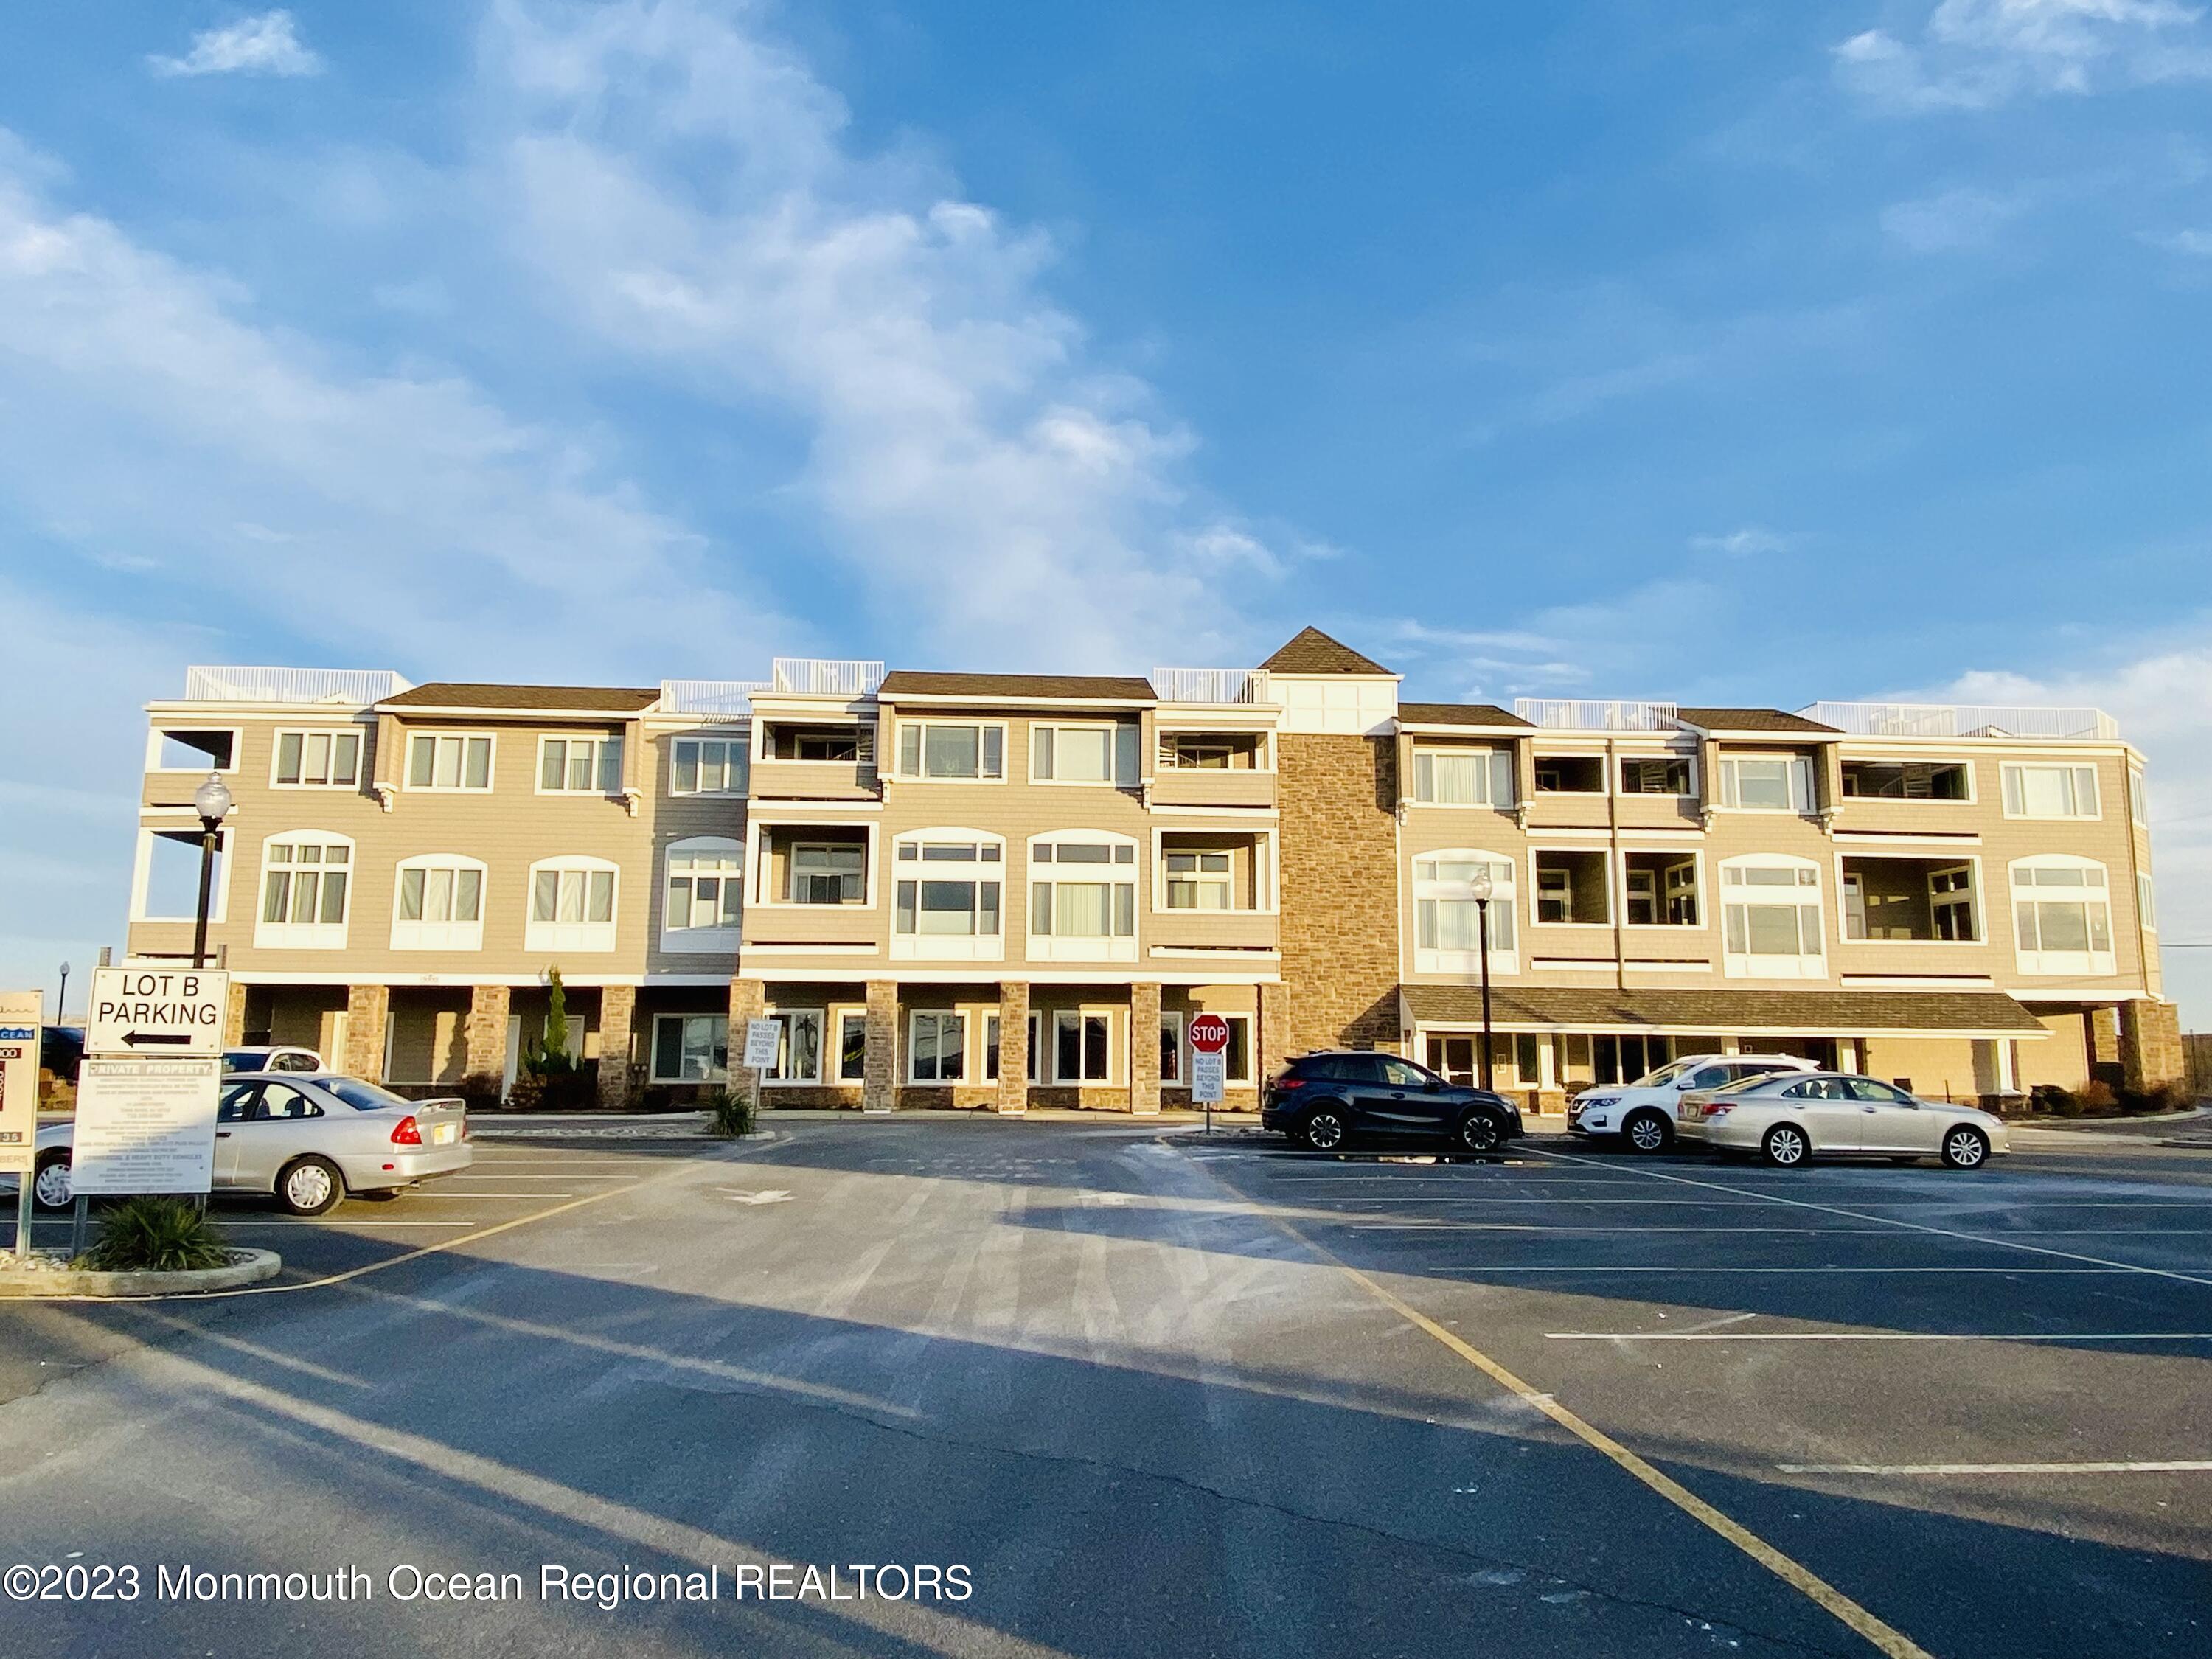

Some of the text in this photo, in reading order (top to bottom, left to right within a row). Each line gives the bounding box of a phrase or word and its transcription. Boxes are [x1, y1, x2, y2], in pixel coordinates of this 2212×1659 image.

[122, 975, 198, 997] LOT B
[99, 1002, 216, 1025] PARKING
[1192, 1026, 1226, 1041] STOP
[91, 1064, 210, 1074] PRIVATE PROPERTY
